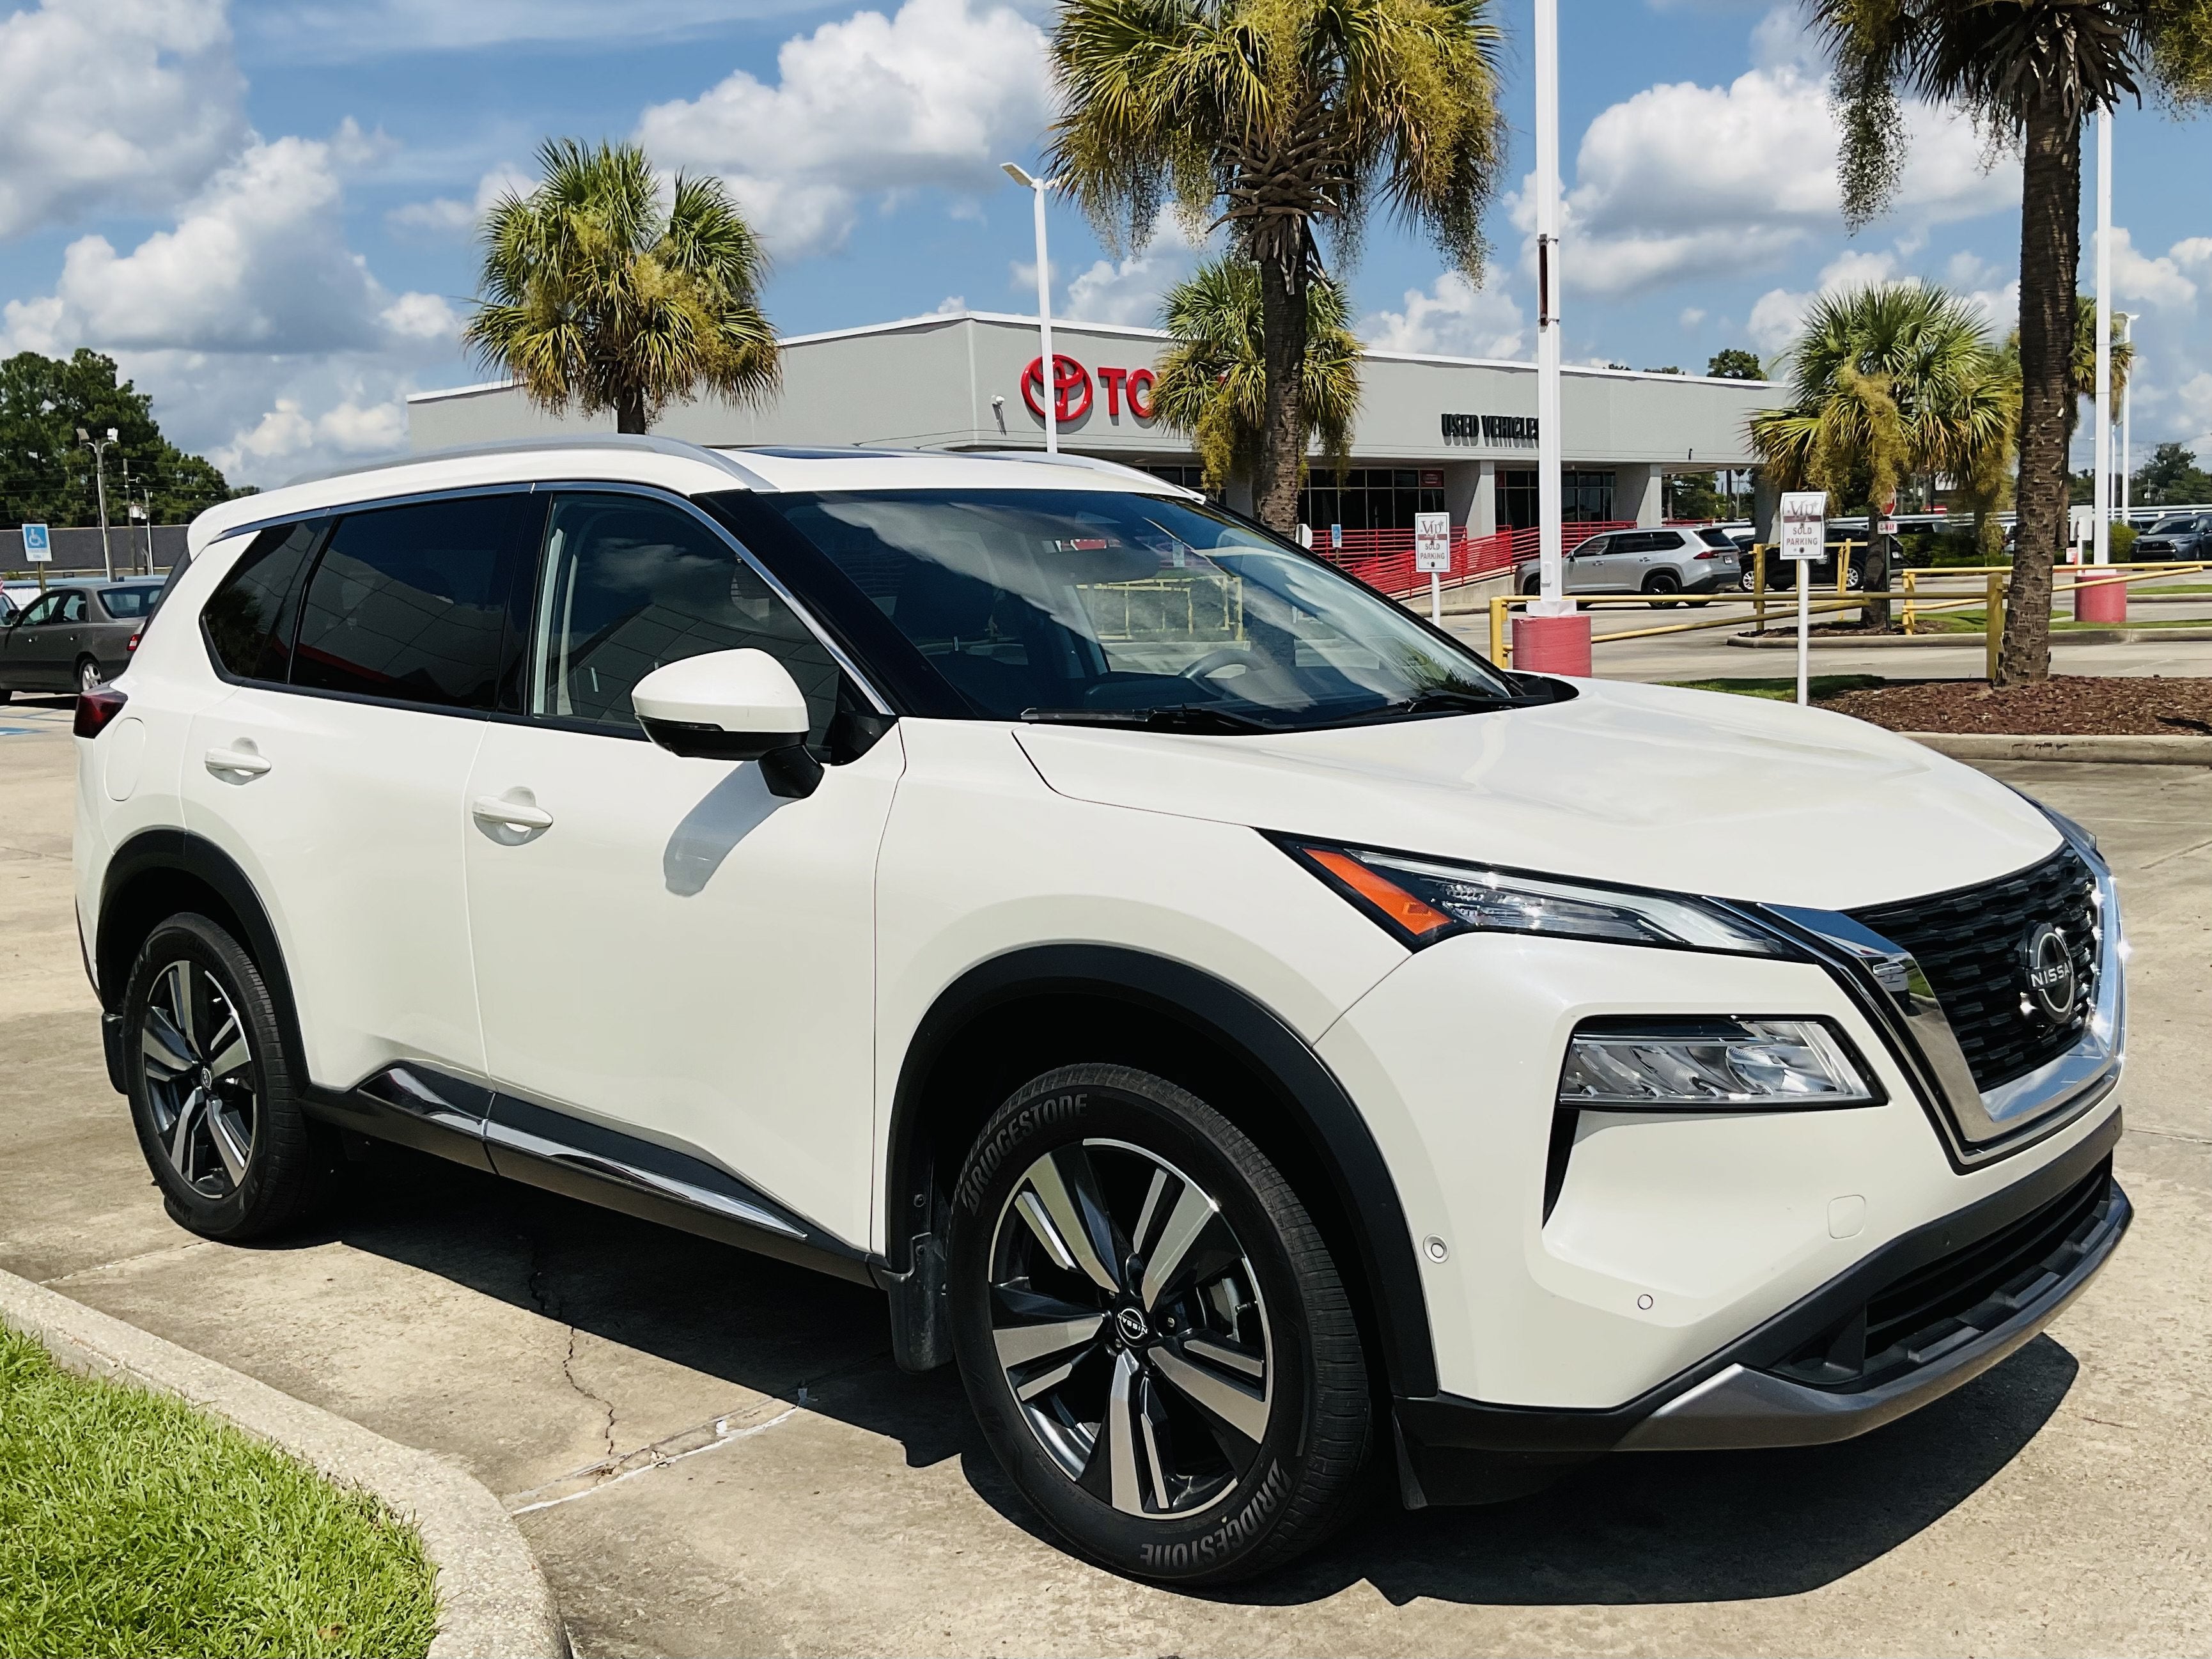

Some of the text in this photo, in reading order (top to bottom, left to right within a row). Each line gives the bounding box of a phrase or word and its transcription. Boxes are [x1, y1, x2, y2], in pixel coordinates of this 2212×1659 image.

[1441, 414, 1539, 439] USED VEHICLE
[1793, 527, 1812, 535] SOLD
[960, 1093, 1087, 1217] BRIDGESTONE
[1117, 1312, 1148, 1334] NISSAN
[1140, 1457, 1293, 1567] BRIDGESTONE
